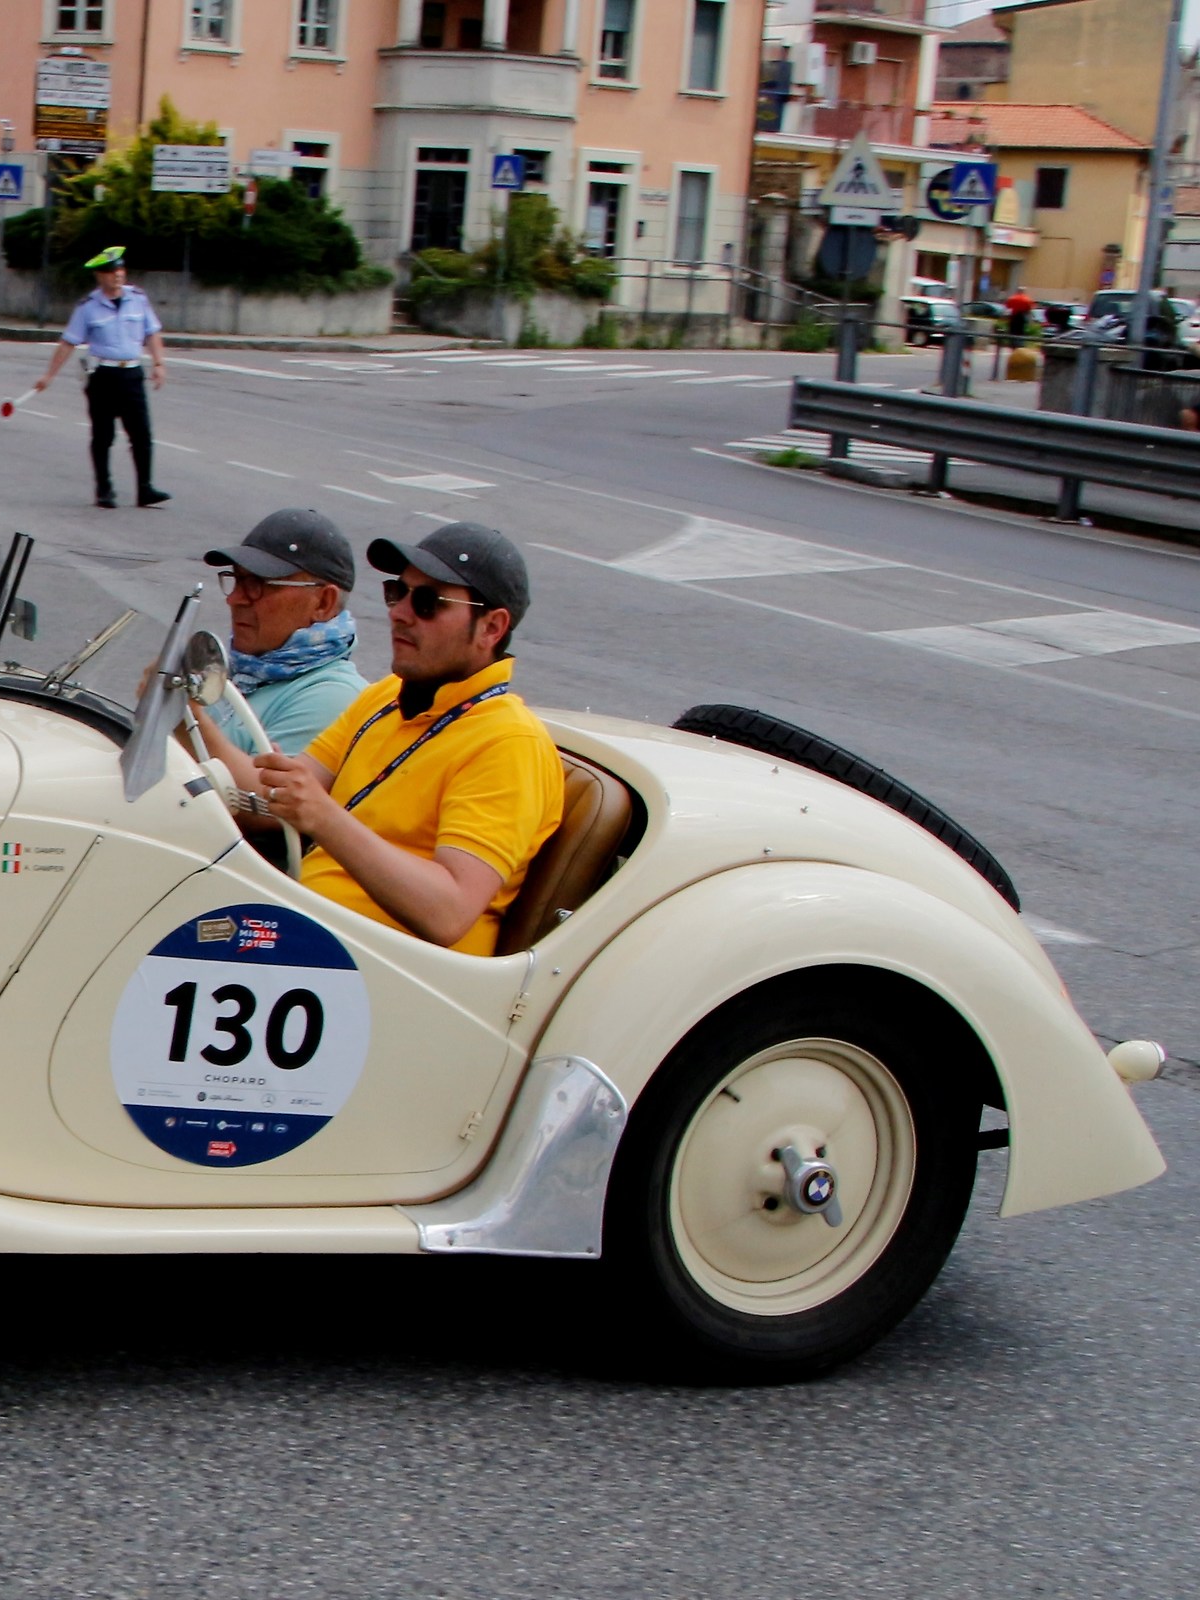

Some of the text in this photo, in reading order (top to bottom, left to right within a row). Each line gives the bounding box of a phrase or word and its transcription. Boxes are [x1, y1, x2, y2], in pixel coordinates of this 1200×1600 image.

[241, 919, 279, 929] 1000
[239, 929, 278, 939] MIGLIA
[238, 939, 275, 949] 2018
[165, 981, 324, 1070] 130
[204, 1074, 267, 1086] CHOPARD
